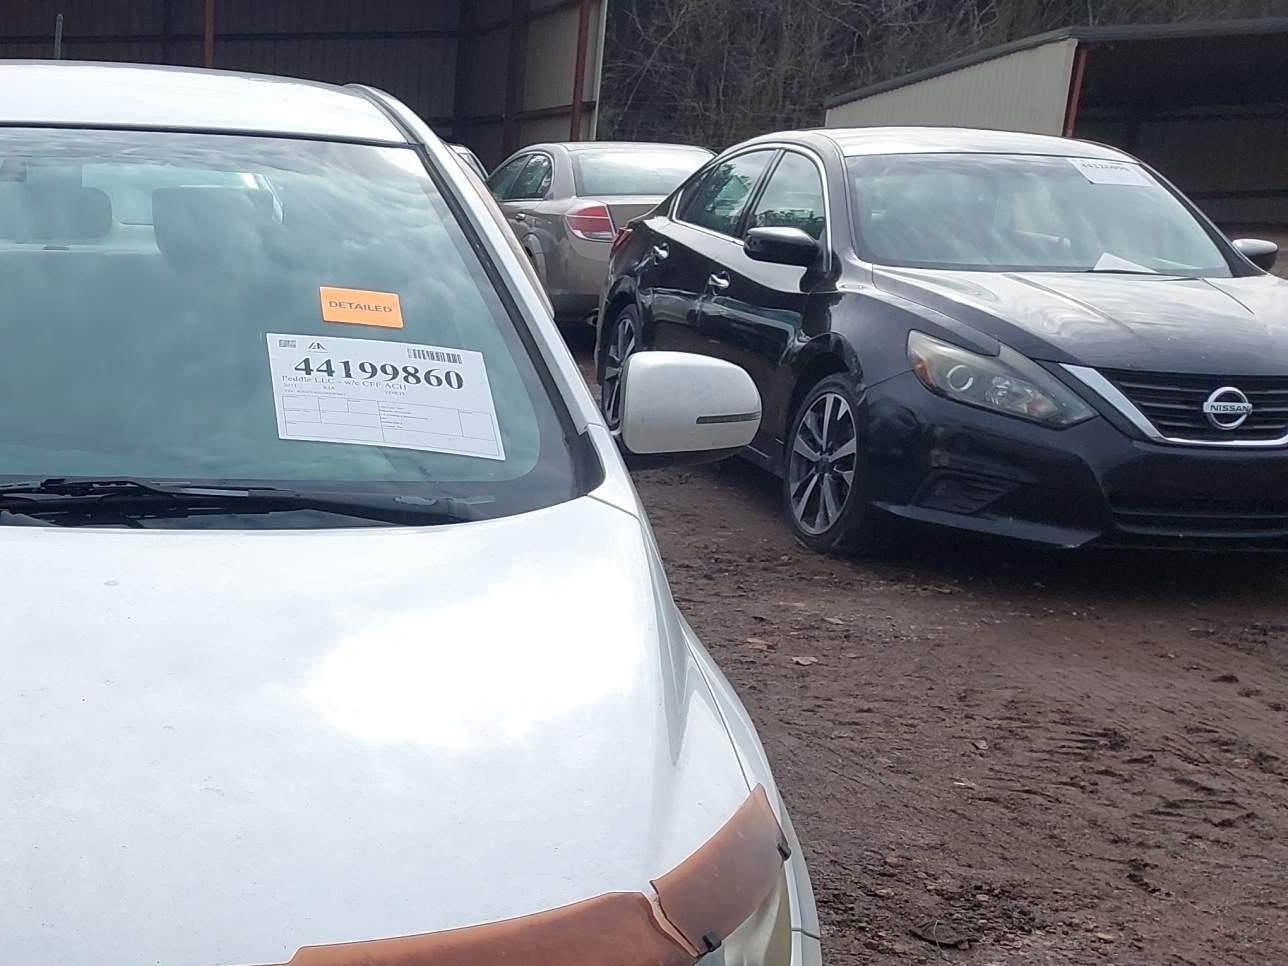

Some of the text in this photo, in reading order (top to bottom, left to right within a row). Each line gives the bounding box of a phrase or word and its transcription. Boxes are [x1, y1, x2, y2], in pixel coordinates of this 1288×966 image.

[328, 300, 393, 313] DETAILED
[294, 357, 464, 390] 44199860
[1210, 404, 1249, 412] NISSAN
